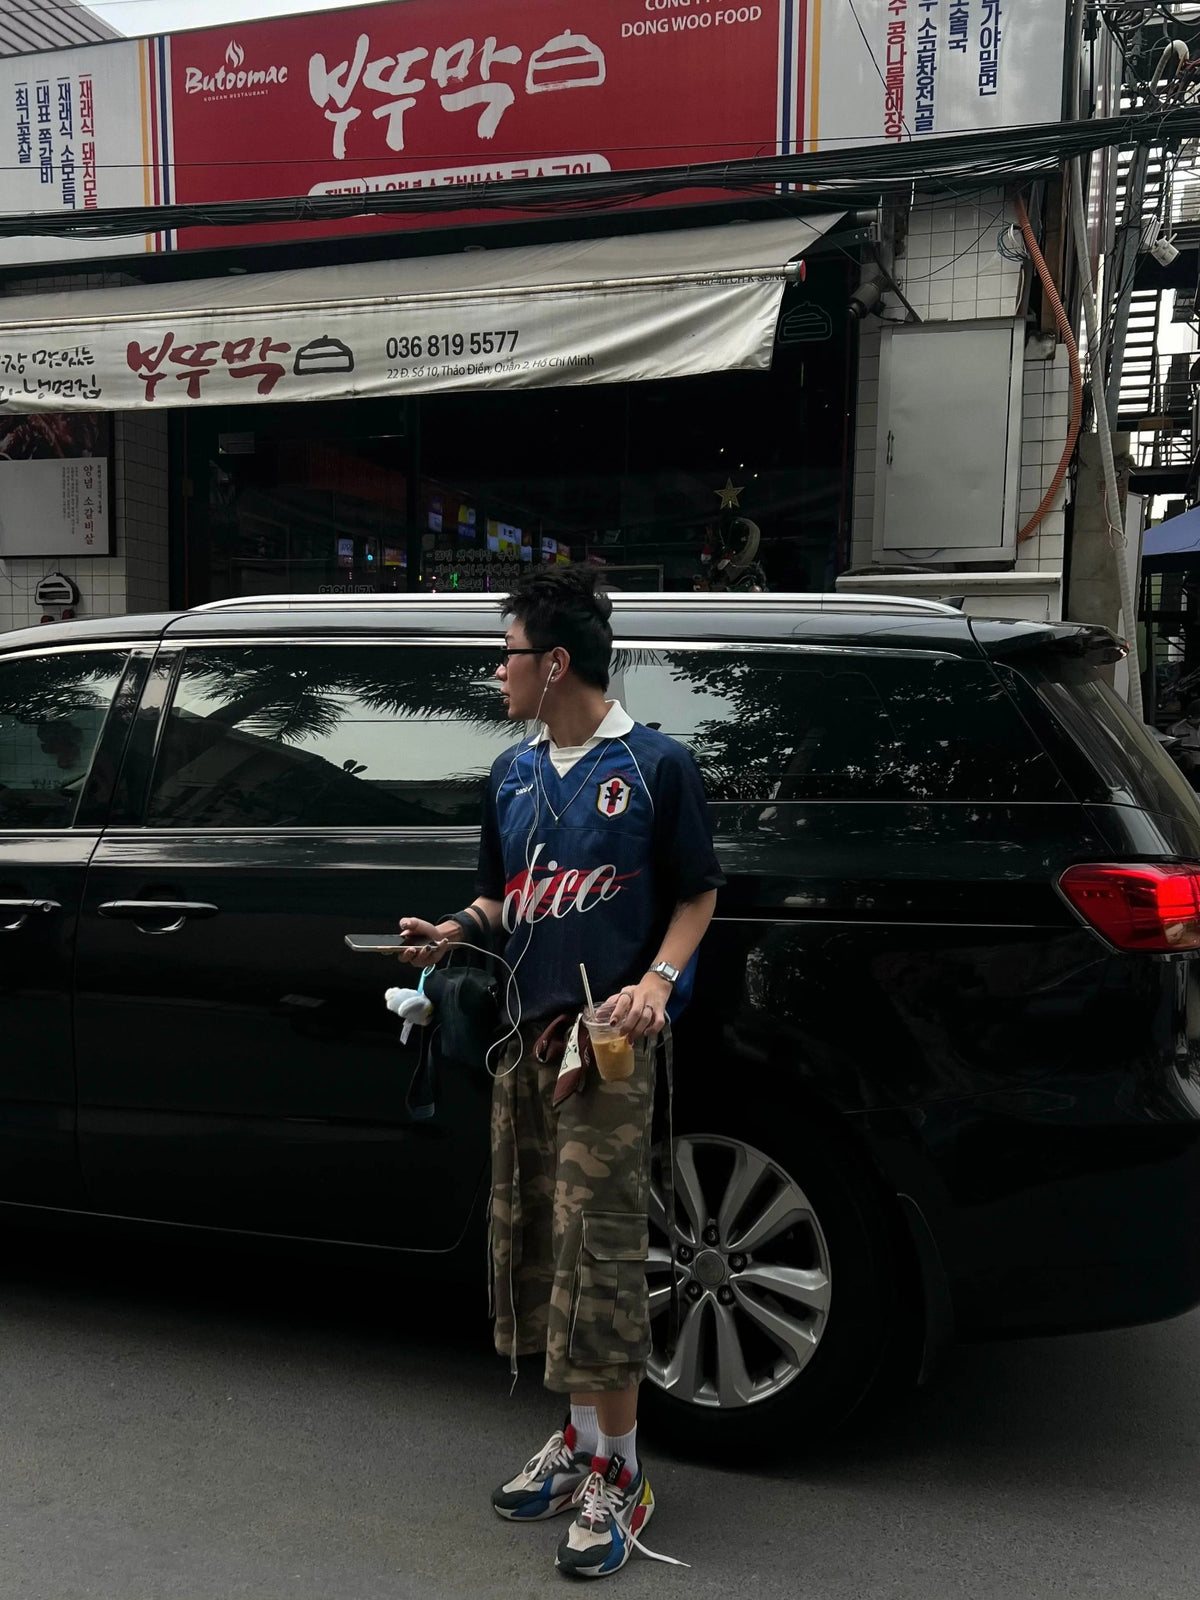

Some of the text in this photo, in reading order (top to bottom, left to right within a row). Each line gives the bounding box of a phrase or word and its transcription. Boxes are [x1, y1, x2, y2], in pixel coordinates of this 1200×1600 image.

[621, 5, 762, 38] DONG WOO FOOD
[978, 0, 1002, 96] 가야밀면
[185, 65, 288, 94] Butoomac
[203, 89, 269, 102] KOREAN RESTAURANT
[36, 85, 52, 123] 대표
[57, 82, 73, 140] 재래식
[79, 80, 95, 137] 재래식
[386, 330, 519, 359] 036 819 5577
[386, 369, 399, 379] 22
[411, 363, 425, 378] Số
[427, 366, 440, 378] 10,
[494, 360, 521, 374] Quận
[549, 356, 566, 368] Chí
[568, 354, 595, 367] Minh
